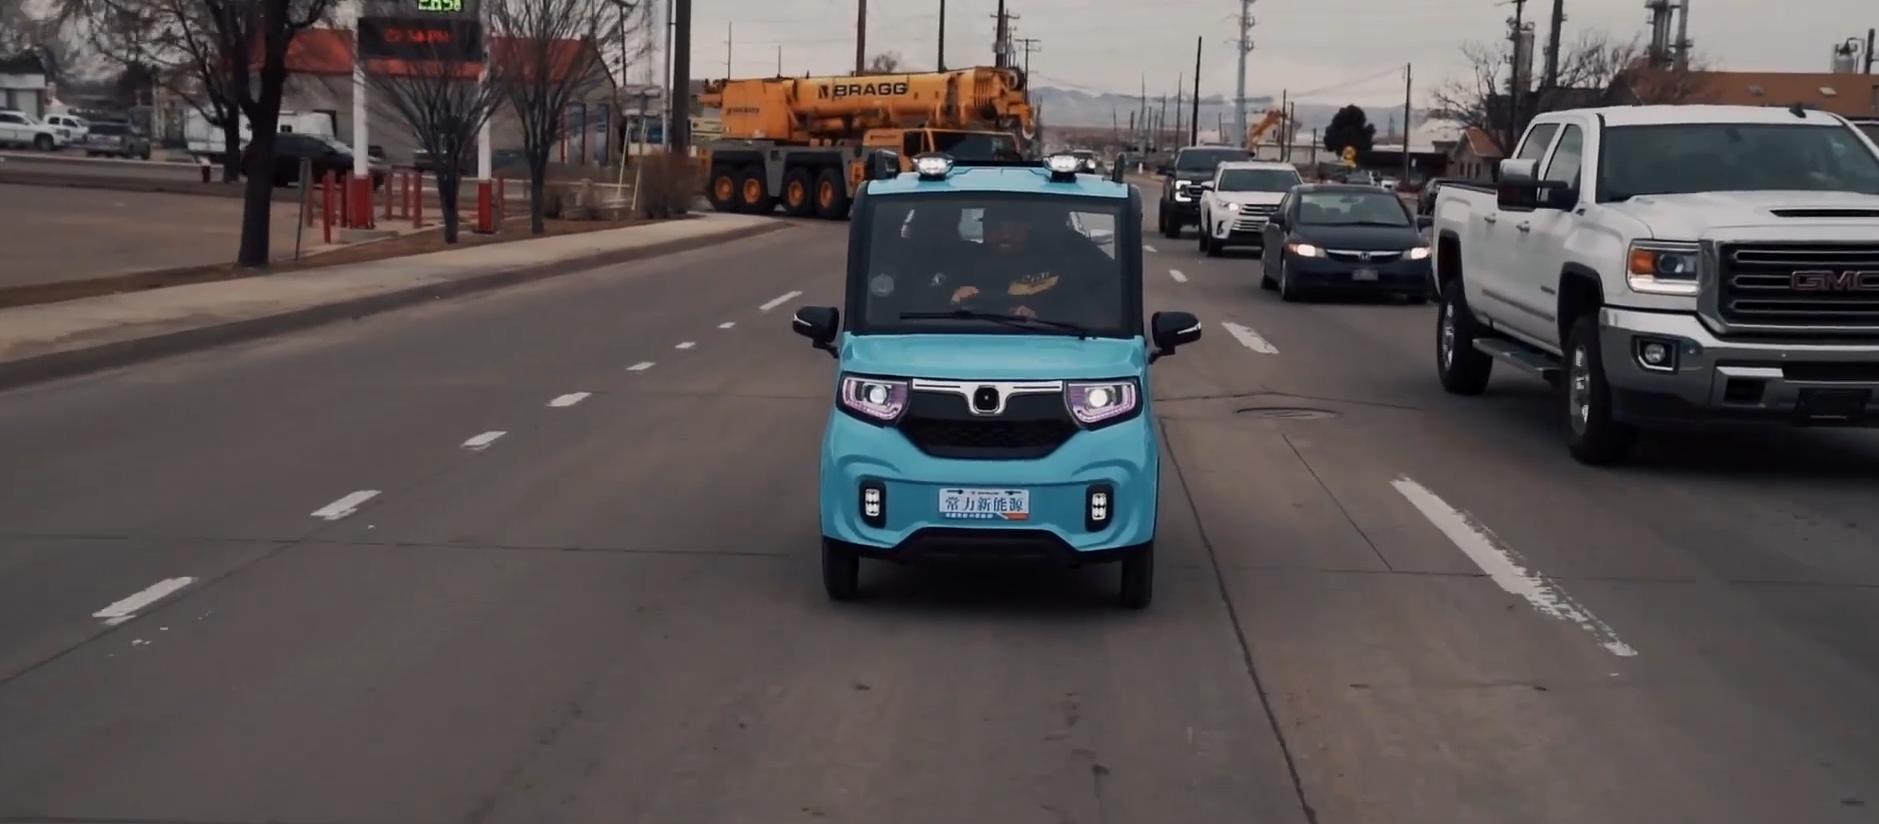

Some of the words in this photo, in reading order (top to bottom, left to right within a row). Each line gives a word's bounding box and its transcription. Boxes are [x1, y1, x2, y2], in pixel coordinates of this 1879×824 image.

[833, 82, 908, 97] BRAGG
[1791, 270, 1879, 291] GMC
[945, 496, 1024, 512] 常力新能源
